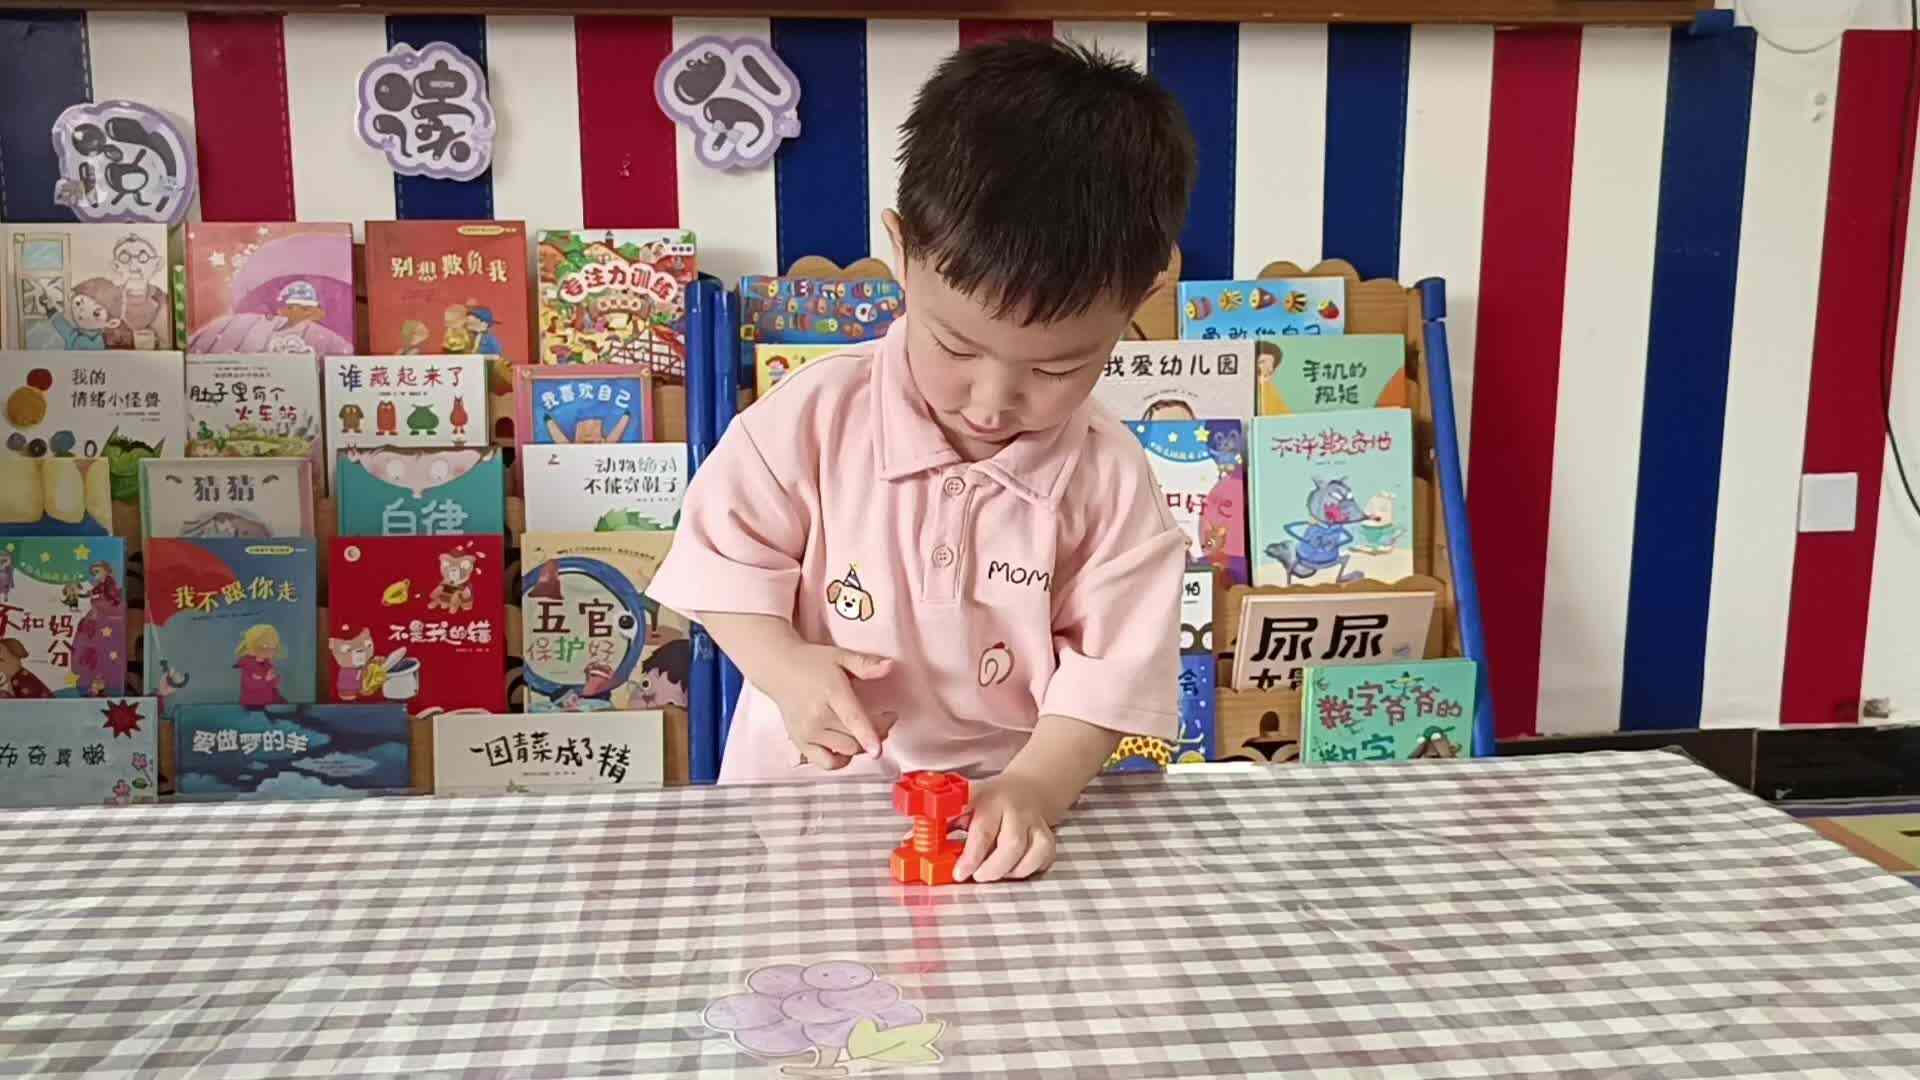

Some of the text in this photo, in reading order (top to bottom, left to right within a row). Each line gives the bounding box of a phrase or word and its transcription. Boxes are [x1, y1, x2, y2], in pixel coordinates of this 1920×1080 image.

[391, 249, 508, 283] 别想欺负我
[562, 266, 673, 300] 专注力训练
[72, 368, 106, 385] 我的
[338, 363, 464, 392] 谁藏起来了
[1303, 359, 1366, 382] 手机的
[71, 391, 160, 408] 情绪小怪兽
[190, 382, 285, 405] 肚子里有个
[542, 383, 632, 409] 我喜欢自己
[1314, 385, 1361, 405] 规矩
[235, 405, 297, 423] 火车站
[193, 475, 256, 502] 猜猜
[172, 576, 299, 613] 我不跟你走
[533, 598, 614, 638] 五官
[388, 620, 492, 645] 不是我的猫
[1250, 614, 1389, 661] 尿尿
[528, 636, 615, 663] 保护好
[1317, 681, 1462, 729] 数字爷爷的
[192, 729, 309, 754] 爱做梦的羊
